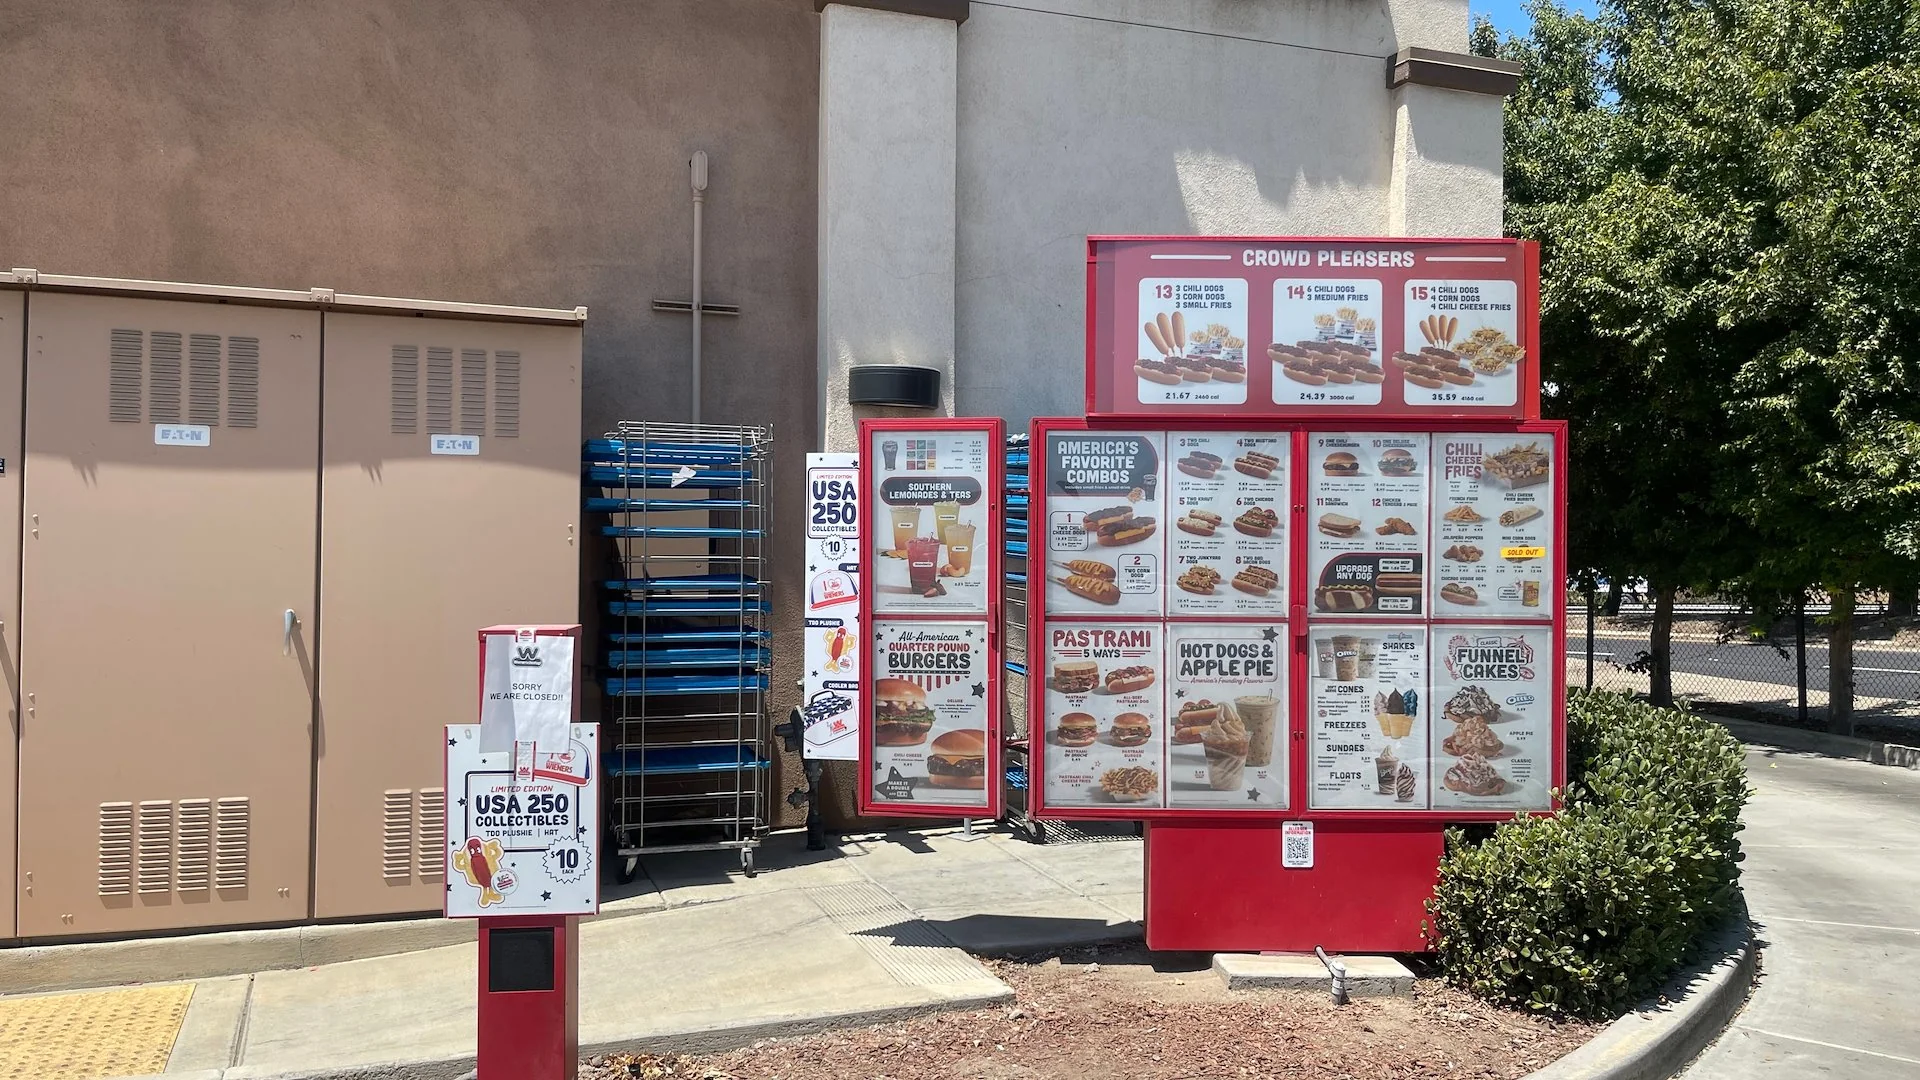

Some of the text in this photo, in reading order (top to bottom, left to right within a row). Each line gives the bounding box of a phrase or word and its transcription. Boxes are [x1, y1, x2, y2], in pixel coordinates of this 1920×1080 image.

[1243, 249, 1415, 268] CROWD PLEASERS
[1156, 285, 1173, 299] 13
[1287, 286, 1305, 299] 14
[1411, 286, 1428, 301] 15
[1166, 392, 1191, 400] 21.67
[1300, 392, 1326, 400] 24.39
[1058, 441, 1139, 455] AMERICA'S
[1180, 439, 1185, 447] 3
[1237, 439, 1243, 447] 4
[1319, 439, 1324, 447] 9
[1373, 440, 1381, 448] 10
[1446, 443, 1482, 456] CHILI
[1062, 456, 1135, 469] FAVORITE
[1446, 456, 1482, 465] CHEESE
[1067, 470, 1130, 483] COMBOS
[1446, 466, 1482, 480] FRIES
[813, 481, 857, 501] USA
[908, 483, 952, 491] SOUTHERN
[890, 491, 939, 499] LEMONADES
[950, 491, 971, 499] TEAS
[1180, 498, 1185, 506] 5
[1236, 498, 1242, 506] 6
[1317, 498, 1324, 506] 11
[813, 502, 857, 524] 250
[1067, 514, 1071, 523] 1
[825, 541, 840, 553] $10
[1134, 556, 1141, 565] 2
[1179, 556, 1185, 564] 7
[1236, 556, 1241, 564] 8
[1356, 573, 1373, 581] DOG
[824, 590, 845, 600] WIENERS
[899, 631, 960, 642] All-American
[1053, 630, 1151, 647] PASTRAMI
[889, 643, 970, 652] QUARTER POUND
[1181, 644, 1273, 658] HOT DOGS &
[1084, 649, 1120, 658] 5 WAYS
[1458, 649, 1525, 663] FUNNEL
[889, 653, 971, 669] BURGERS
[1180, 660, 1274, 676] APPLE PIE
[1463, 664, 1518, 679] CAKES
[1506, 695, 1535, 706] OREO
[546, 762, 573, 774] WIENERS
[1330, 772, 1362, 780] FLOATS
[476, 794, 569, 815] USA 250
[476, 815, 569, 827] COLLECTIBLES
[551, 849, 579, 869] $10
